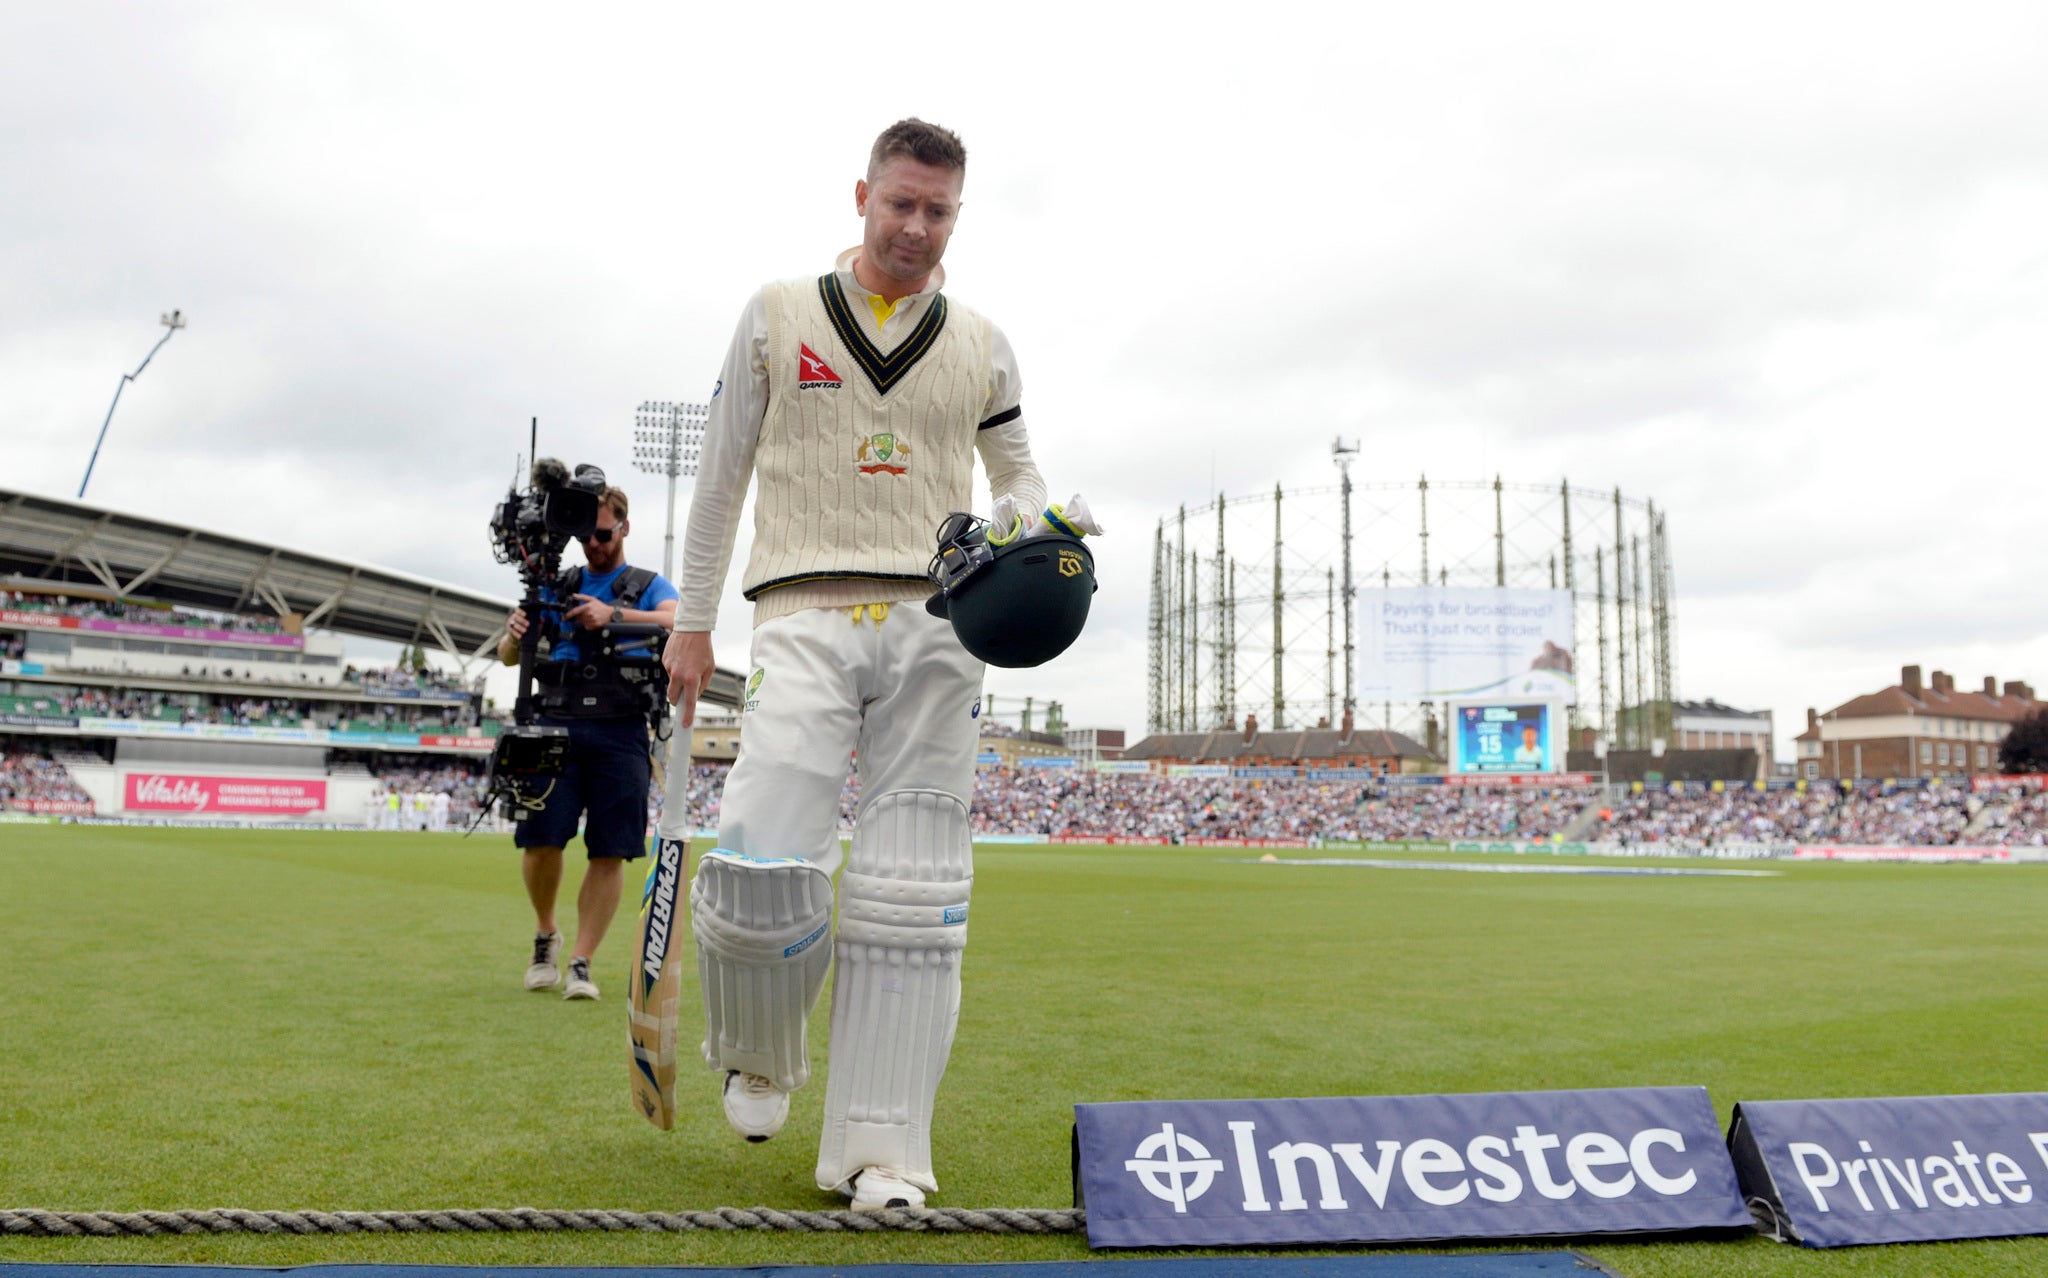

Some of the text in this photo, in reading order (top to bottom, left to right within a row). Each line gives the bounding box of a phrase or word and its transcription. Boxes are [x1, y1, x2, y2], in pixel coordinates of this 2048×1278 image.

[799, 382, 842, 390] QANTAS
[1383, 602, 1434, 617] Paying
[1438, 601, 1460, 615] for
[1384, 621, 1429, 635] That's
[1431, 622, 1459, 636] just
[1464, 623, 1490, 635] not
[1478, 735, 1502, 754] 15
[137, 774, 210, 812] Vitality
[272, 797, 290, 808] FOR
[645, 840, 680, 981] SPARTAN
[1228, 1120, 1697, 1213] Investec
[1788, 1138, 2033, 1213] Private
